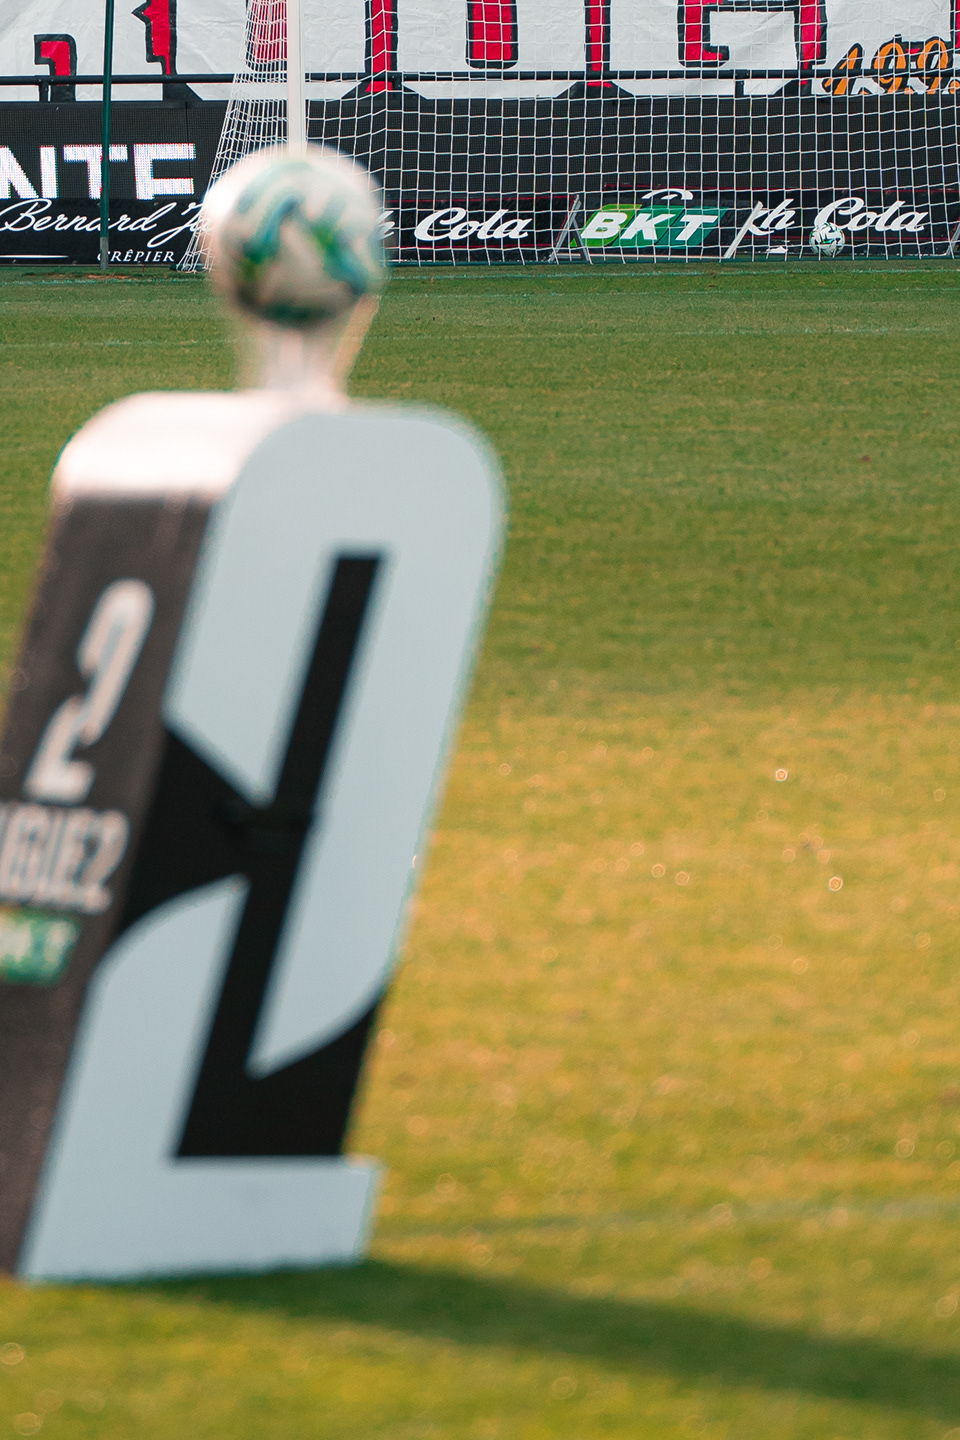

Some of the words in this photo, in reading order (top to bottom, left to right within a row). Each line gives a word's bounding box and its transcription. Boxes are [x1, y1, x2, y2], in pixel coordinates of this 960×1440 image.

[414, 207, 533, 242] Cola
[581, 212, 718, 242] BKT
[814, 196, 930, 233] Cola
[24, 578, 156, 804] 2
